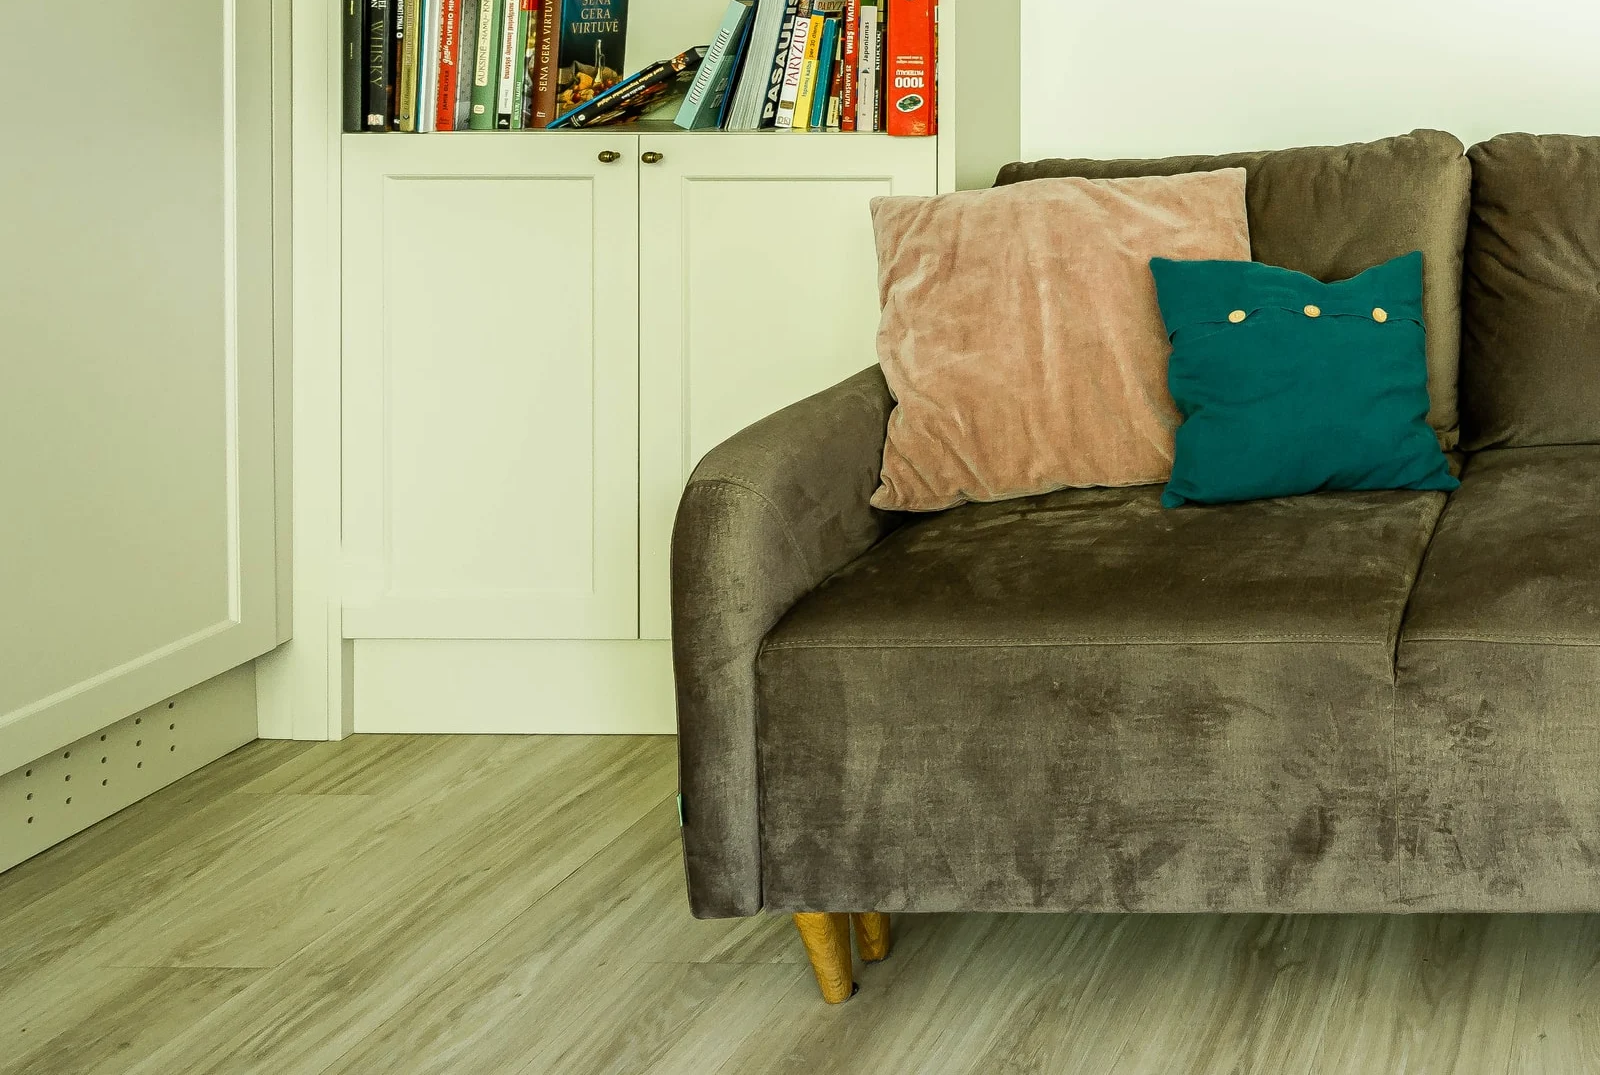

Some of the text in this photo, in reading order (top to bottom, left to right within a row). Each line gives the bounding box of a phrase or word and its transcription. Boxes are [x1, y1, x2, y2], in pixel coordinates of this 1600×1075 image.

[571, 19, 619, 33] VIRTUVĖ
[581, 8, 611, 19] GERA
[370, 20, 383, 87] WHISKY
[846, 30, 854, 55] ŠEIMA
[477, 46, 486, 83] AUKSINĖ
[539, 37, 550, 92] SENA GERA
[895, 77, 925, 88] 1000
